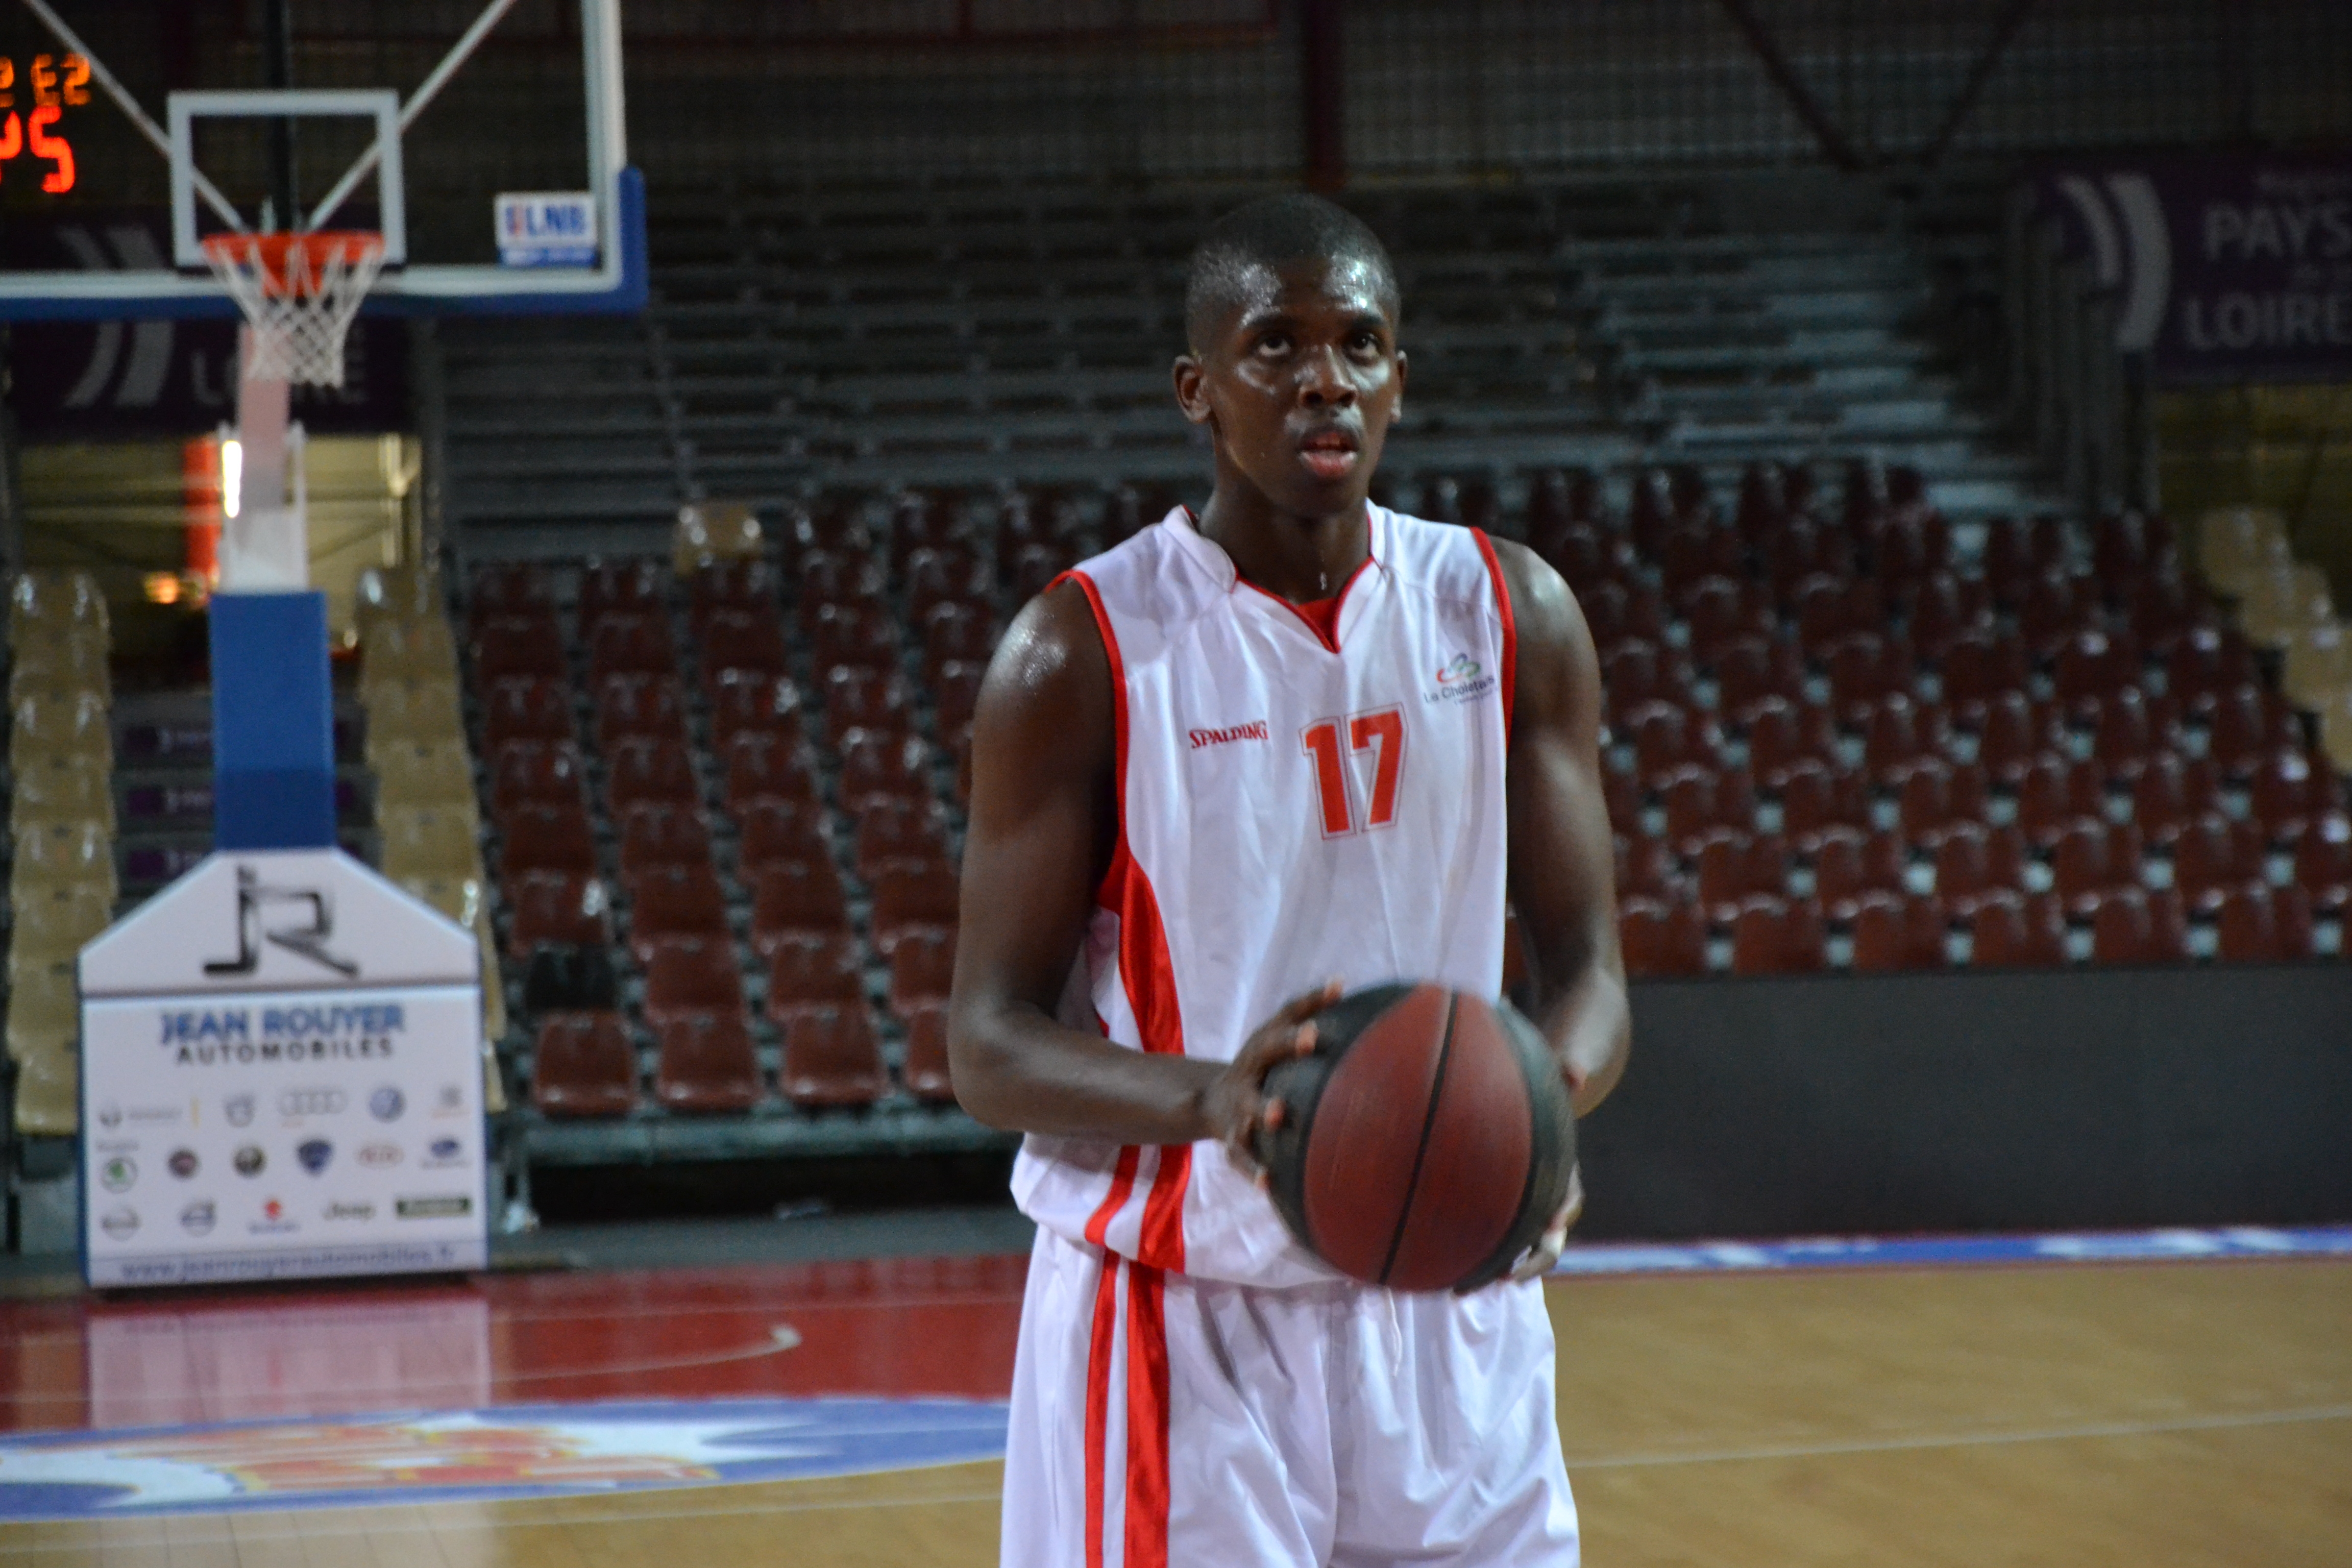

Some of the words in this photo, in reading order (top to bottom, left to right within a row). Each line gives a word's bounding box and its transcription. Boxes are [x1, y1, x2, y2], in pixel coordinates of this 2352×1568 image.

[526, 205, 586, 236] LNB
[2203, 199, 2352, 261] PAYS
[1189, 720, 1268, 749] SPALDING
[1299, 702, 1409, 840] 17
[160, 1009, 249, 1044] JEAN
[262, 1004, 405, 1037] ROUYER
[177, 1037, 393, 1065] AUTOMOBILES
